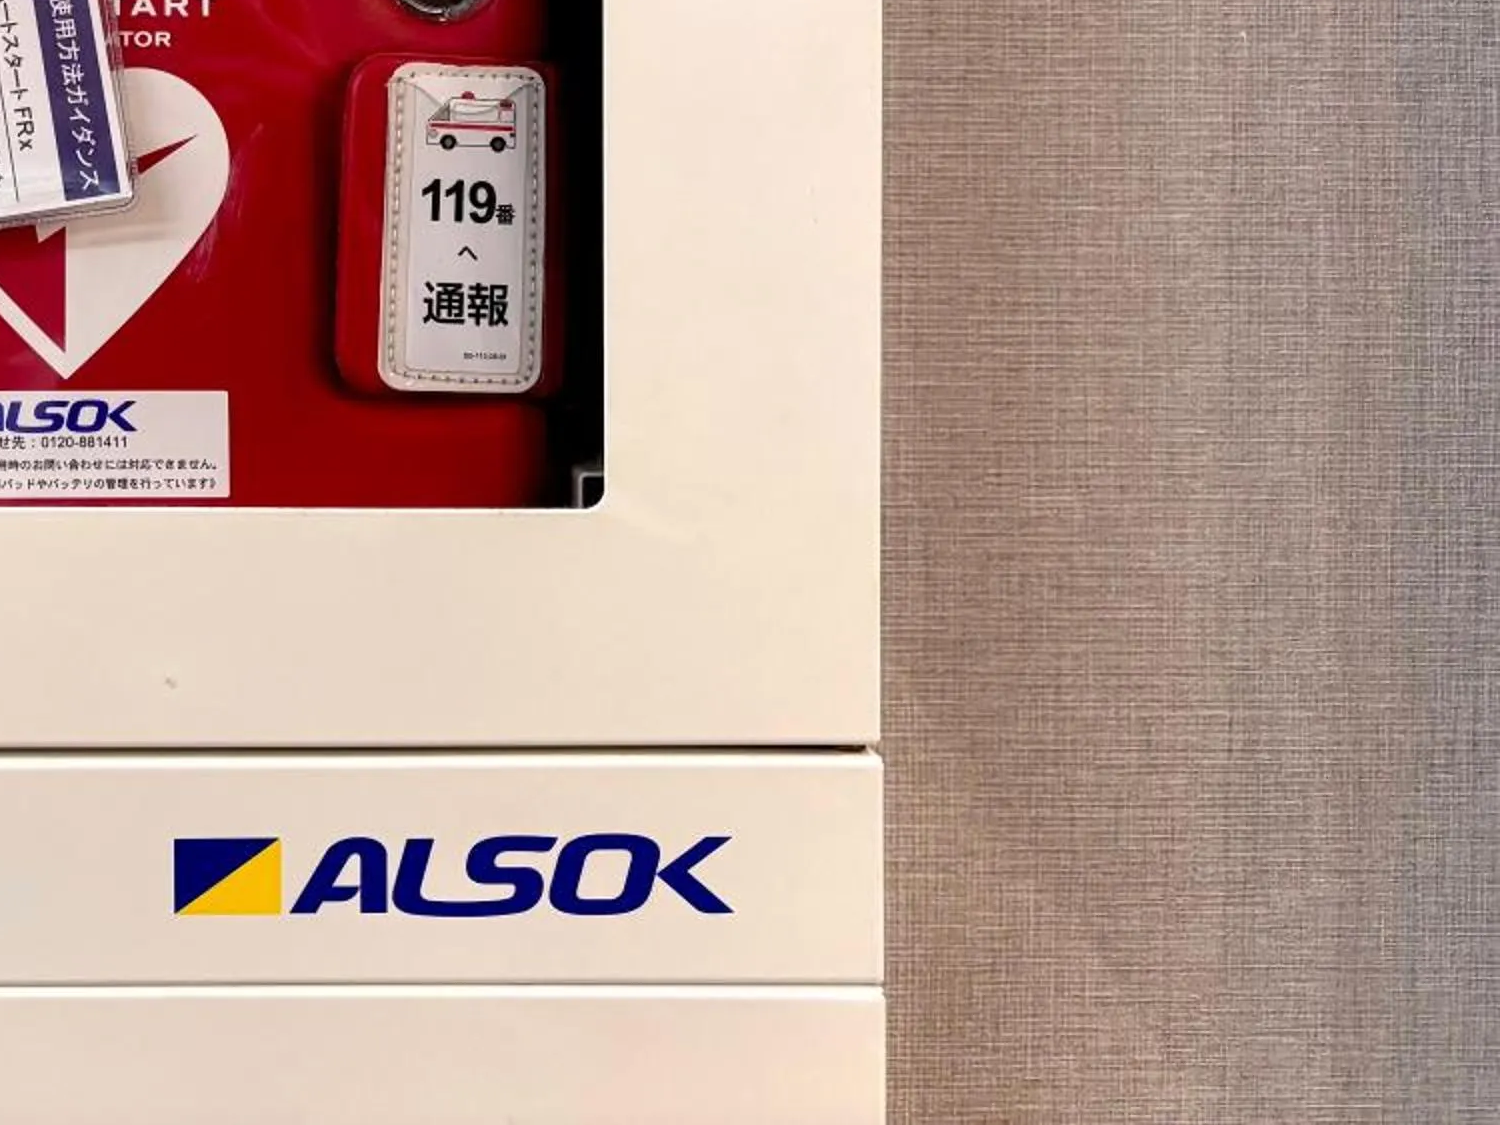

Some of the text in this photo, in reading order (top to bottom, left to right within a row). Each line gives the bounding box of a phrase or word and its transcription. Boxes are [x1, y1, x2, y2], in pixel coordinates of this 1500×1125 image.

[119, 30, 172, 48] TOR
[14, 106, 34, 152] FRx
[421, 178, 516, 226] 119番
[422, 281, 509, 328] 通報
[289, 833, 735, 918] ALSOK
